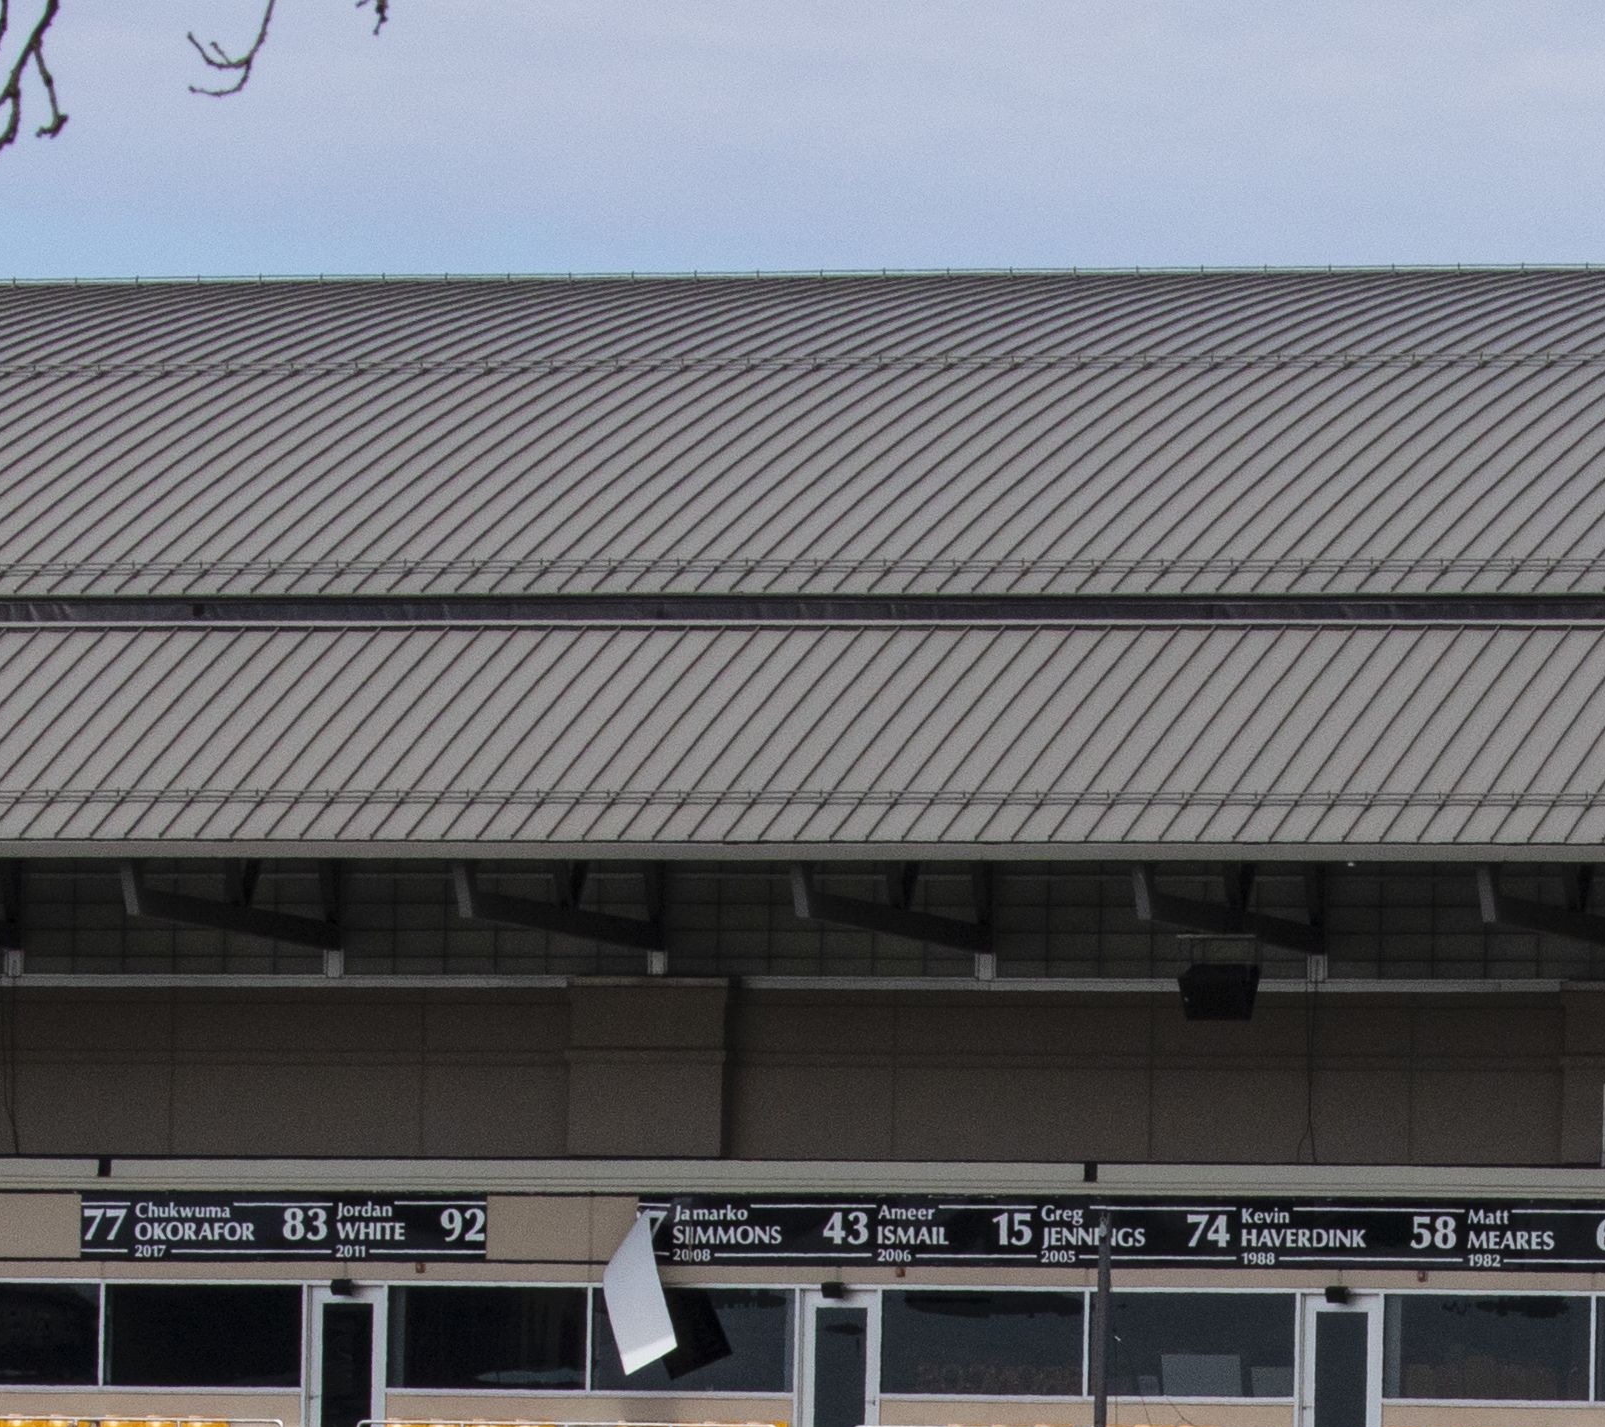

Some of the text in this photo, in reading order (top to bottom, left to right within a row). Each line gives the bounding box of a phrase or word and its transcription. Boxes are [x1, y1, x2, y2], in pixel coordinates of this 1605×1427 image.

[136, 1202, 230, 1218] Chukwuma
[336, 1202, 392, 1220] Jordan
[674, 1204, 748, 1222] Jamarko
[878, 1205, 935, 1220] Ameer
[1042, 1205, 1083, 1226] Greg
[1242, 1208, 1289, 1223] Kevin
[1468, 1210, 1508, 1224] Matt
[84, 1208, 126, 1240] 77
[135, 1222, 254, 1240] OKORAFOR
[283, 1208, 327, 1240] 83
[337, 1222, 404, 1240] WHITE
[440, 1208, 484, 1241] 92
[824, 1212, 868, 1244] 43
[992, 1212, 1032, 1245] 15
[1188, 1214, 1230, 1247] 74
[1410, 1216, 1456, 1248] 58
[674, 1226, 782, 1244] SIMMONS
[878, 1226, 948, 1244] ISMAIL
[1242, 1229, 1366, 1247] HAVERDINK
[1468, 1231, 1554, 1250] MEARES
